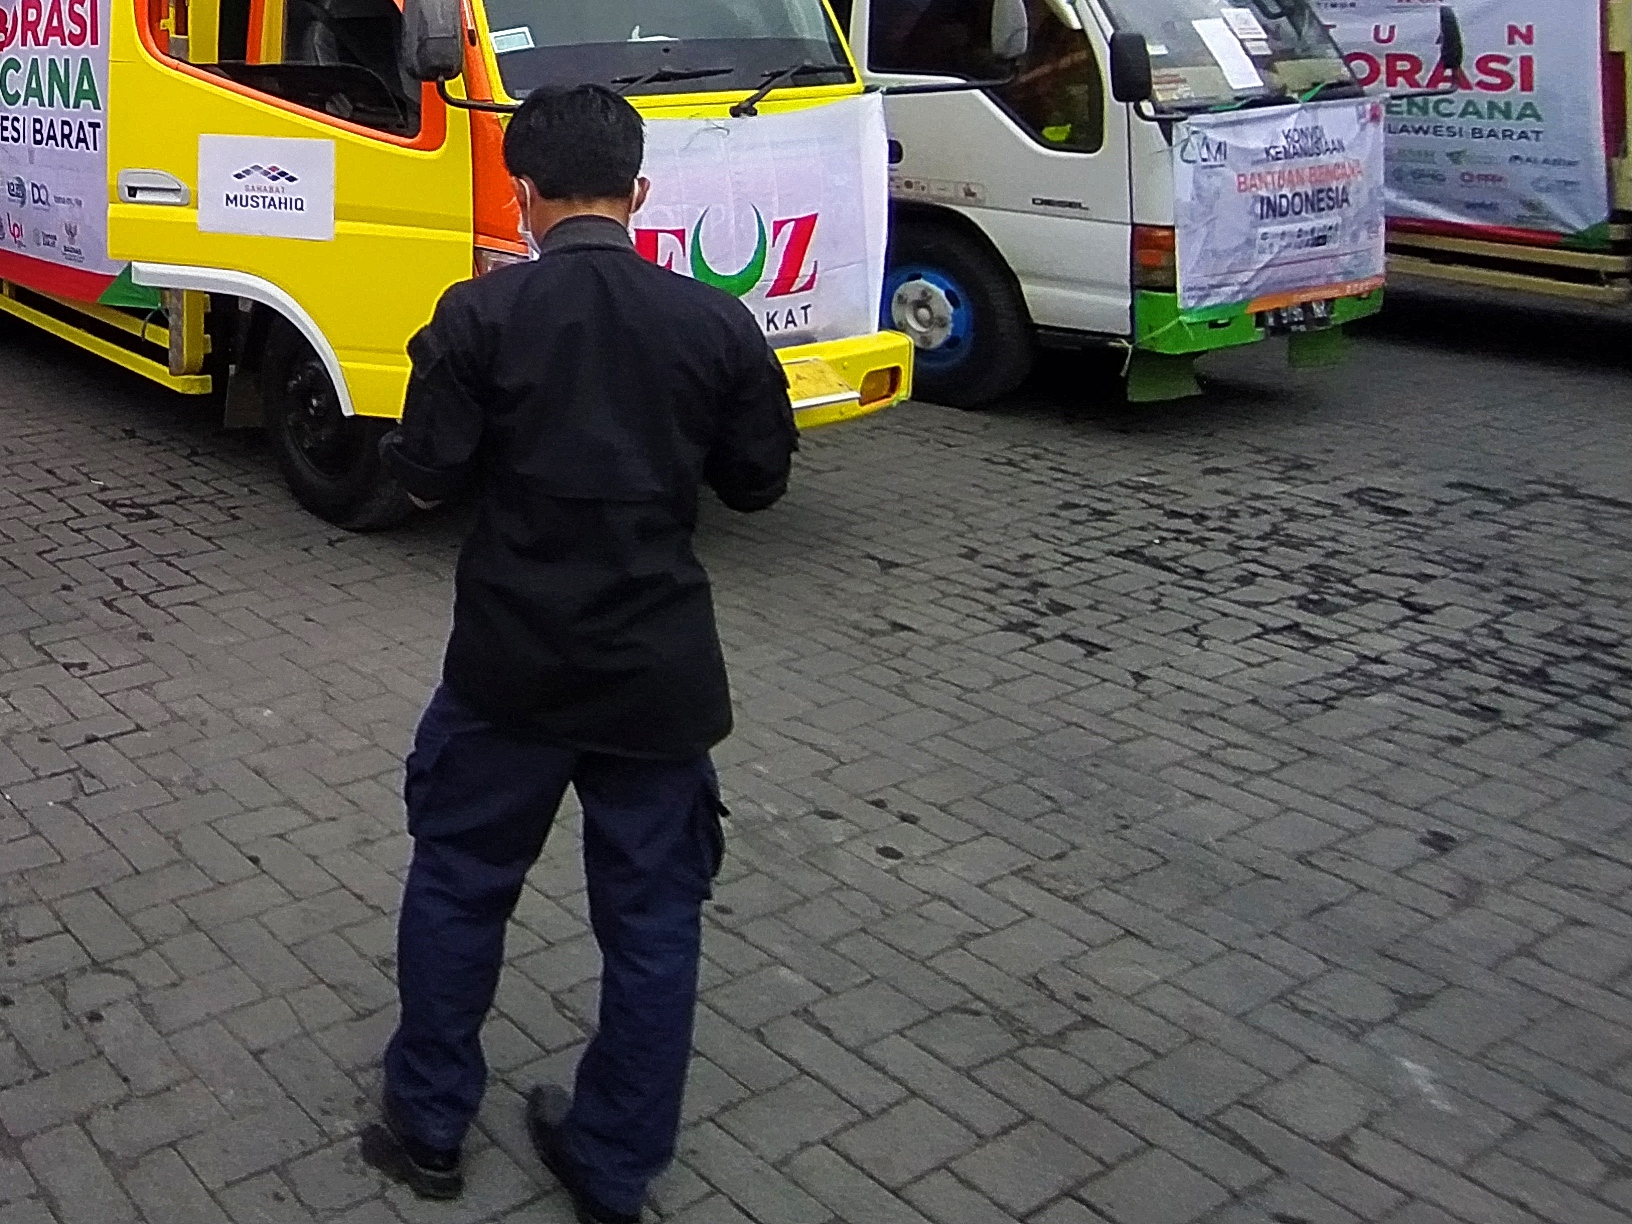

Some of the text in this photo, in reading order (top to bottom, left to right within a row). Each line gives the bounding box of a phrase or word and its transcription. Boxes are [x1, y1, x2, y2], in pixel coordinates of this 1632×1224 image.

[32, 117, 101, 152] BARAT
[1471, 128, 1545, 143] BARAT
[244, 184, 286, 193] SAHABAT
[225, 193, 305, 212] MUSTAHIQ
[1258, 185, 1352, 220] INDONESIA
[762, 303, 812, 332] KAT
